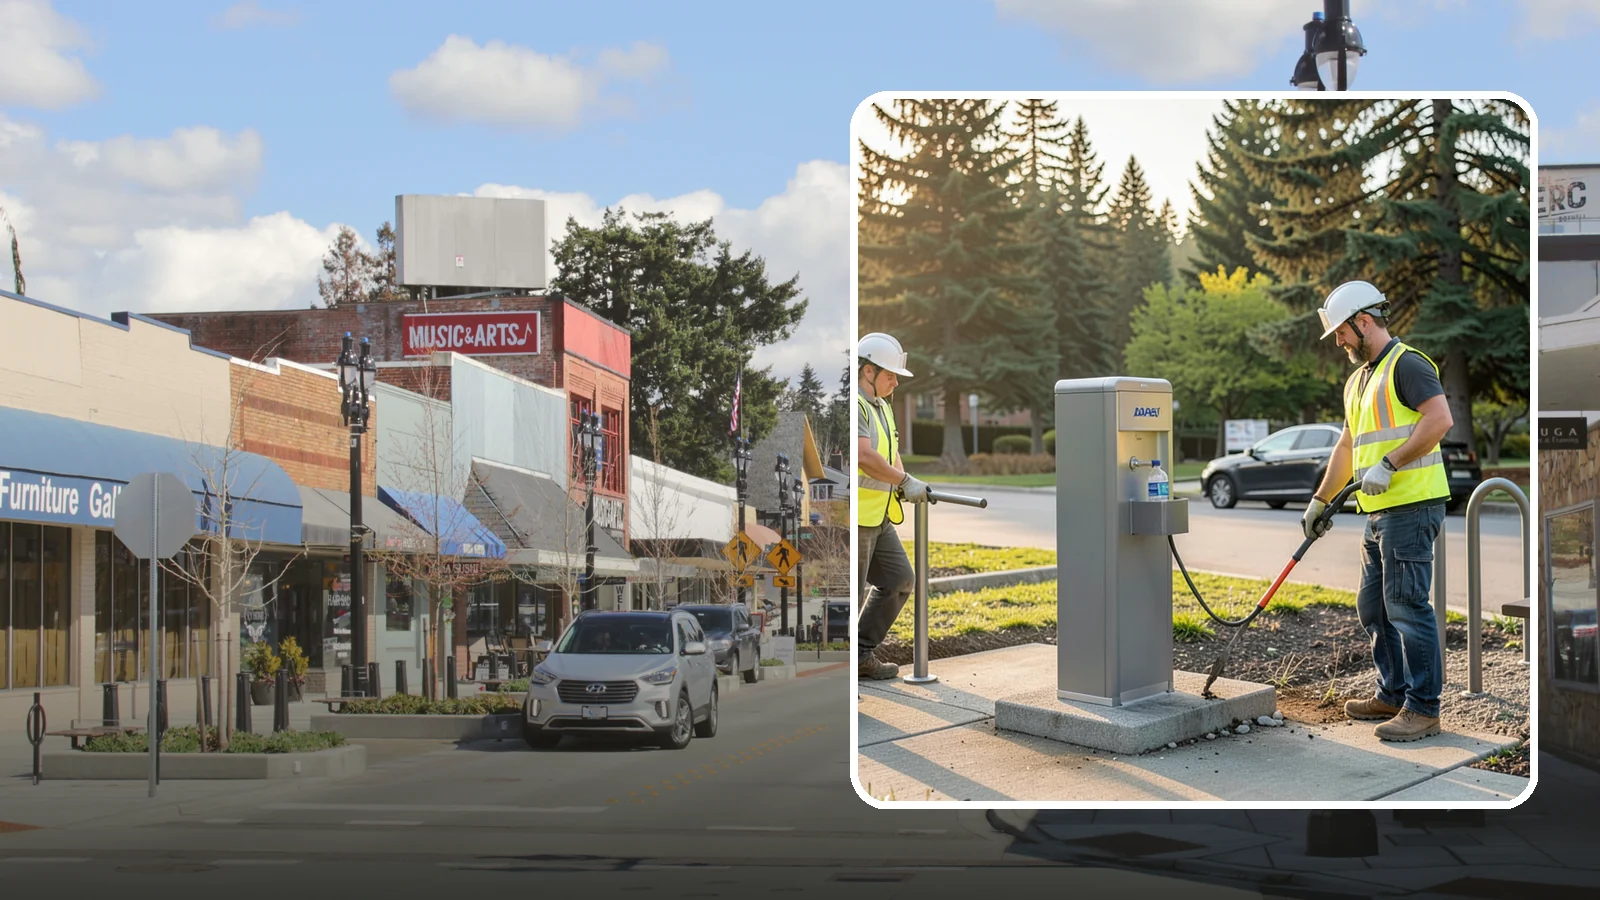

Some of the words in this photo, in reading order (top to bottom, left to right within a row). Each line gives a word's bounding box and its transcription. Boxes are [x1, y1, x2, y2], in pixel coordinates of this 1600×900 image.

[409, 323, 520, 349] MUSIC&ARTS
[0, 471, 79, 515] Furniture
[89, 482, 121, 519] Gal
[453, 563, 479, 574] SUSHI
